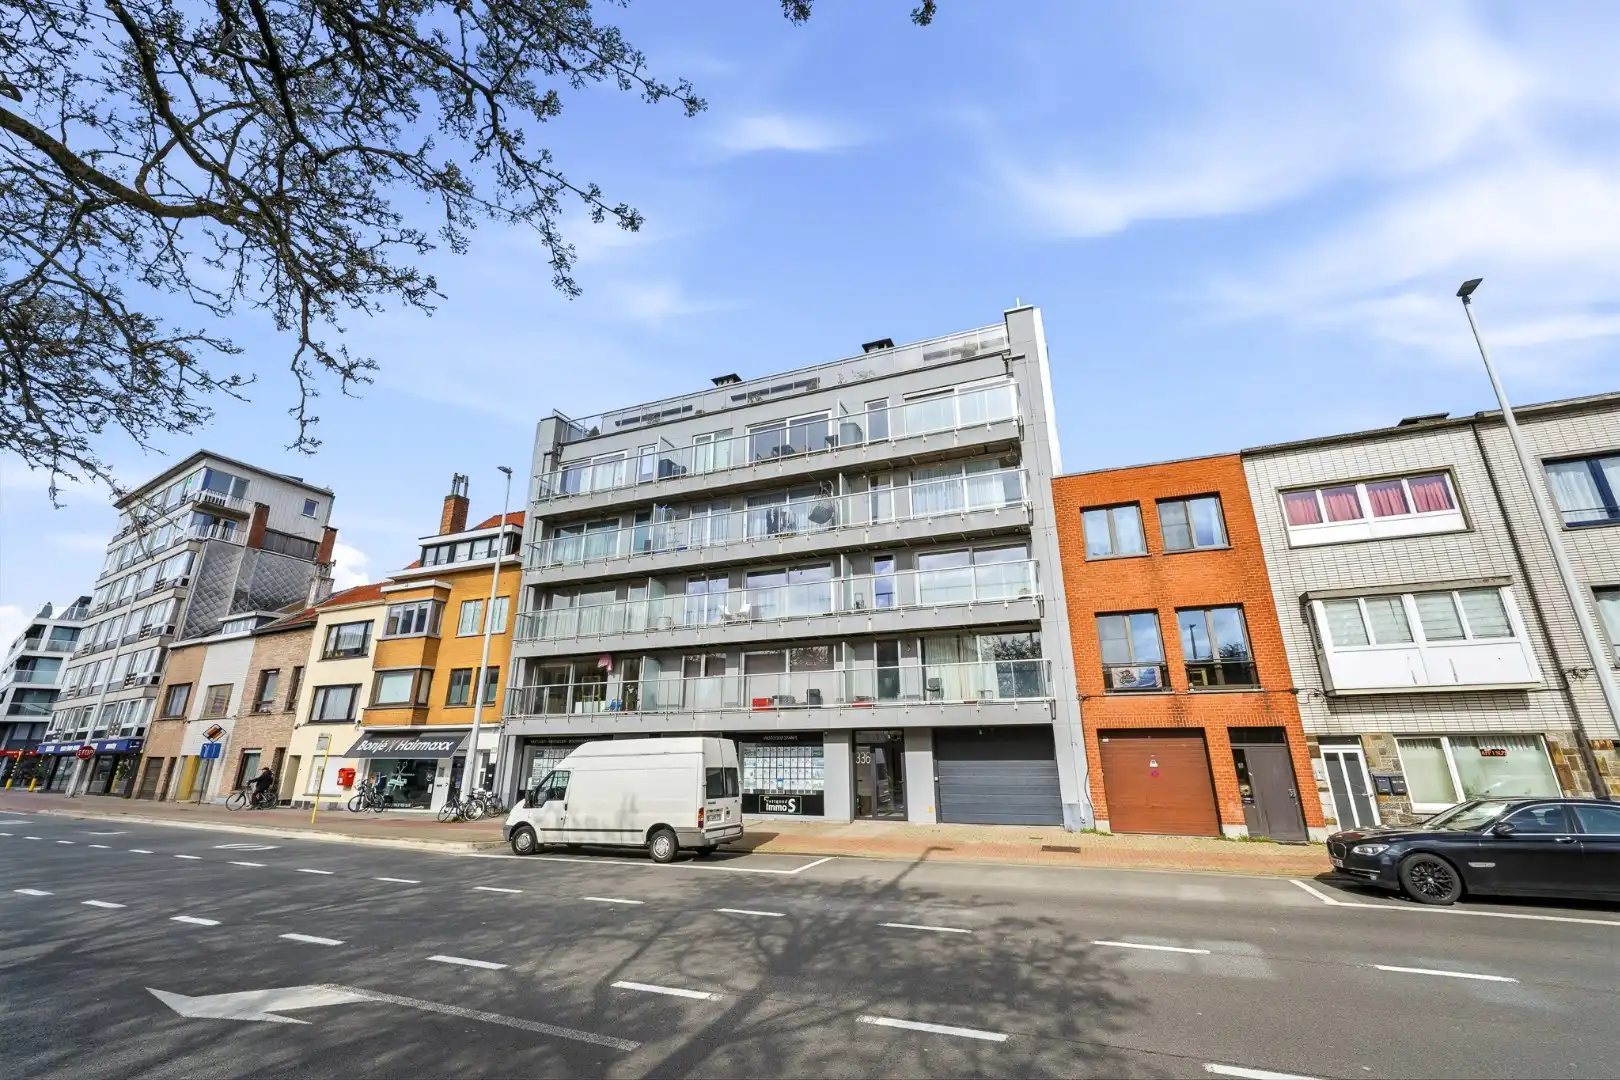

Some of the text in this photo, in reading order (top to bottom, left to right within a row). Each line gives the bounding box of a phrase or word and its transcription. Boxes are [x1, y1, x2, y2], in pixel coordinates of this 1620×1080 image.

[356, 739, 454, 753] Bonjé Hairmaxx
[855, 751, 871, 764] 336
[766, 798, 796, 813] Immo S
